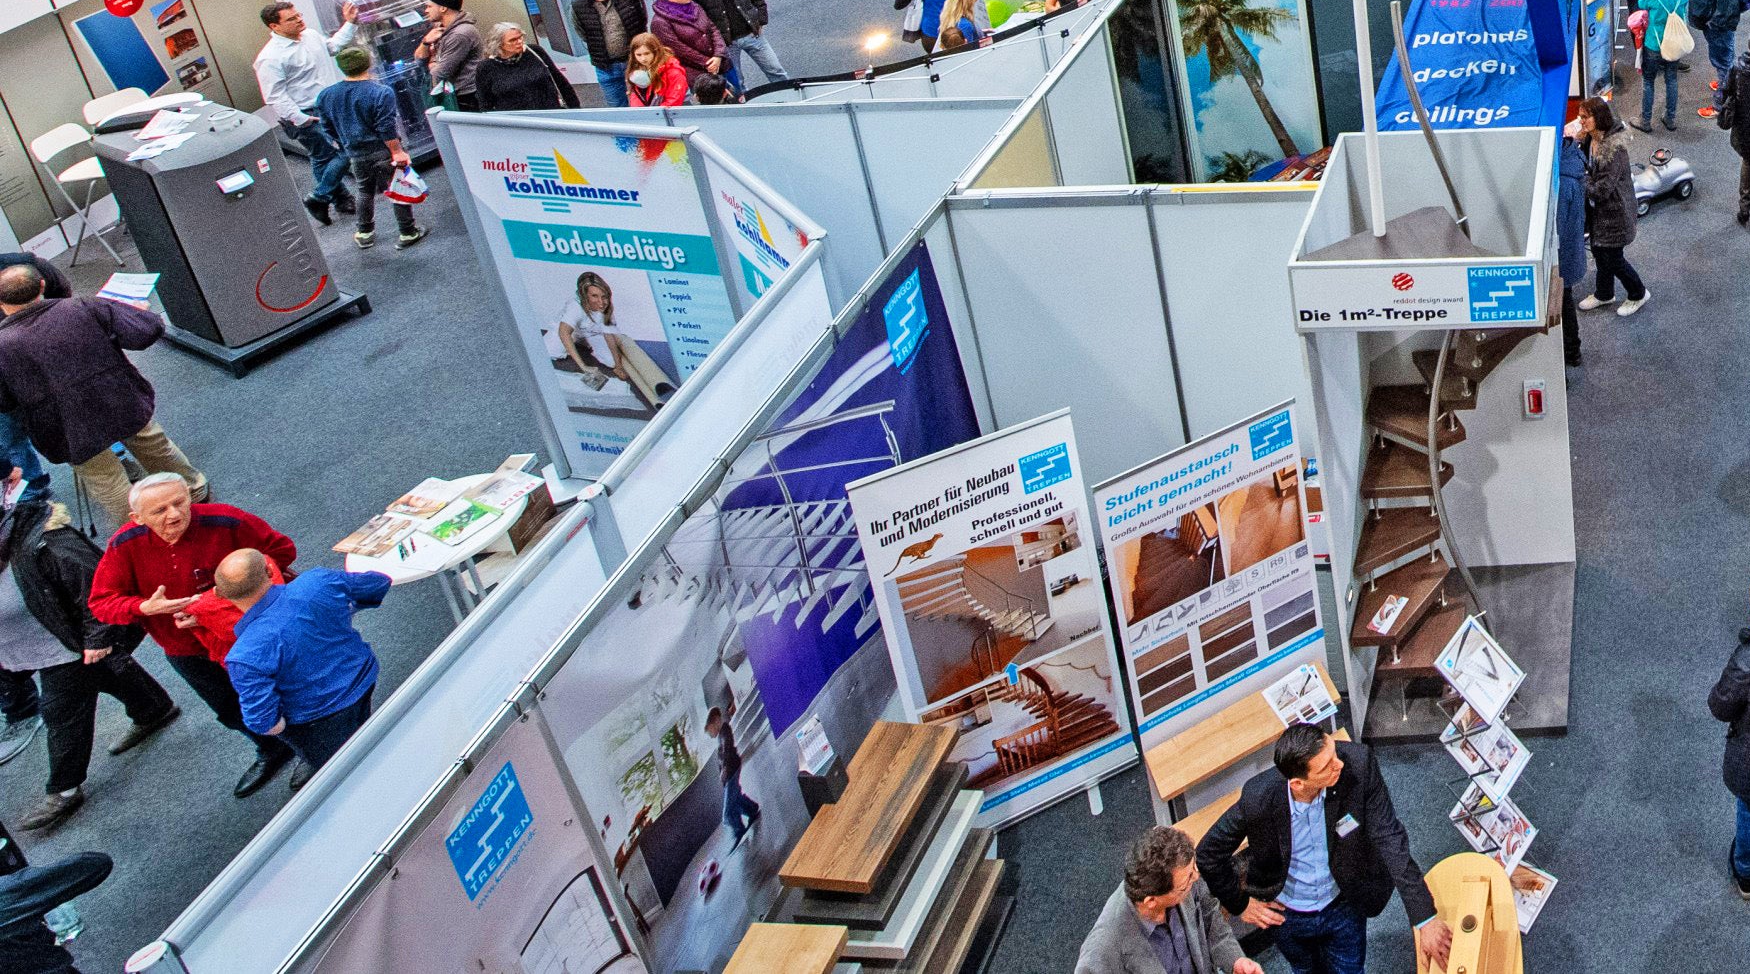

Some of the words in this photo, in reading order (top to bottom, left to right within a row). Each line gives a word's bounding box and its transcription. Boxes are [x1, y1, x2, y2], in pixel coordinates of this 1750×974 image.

[1412, 28, 1529, 49] plafonds
[1414, 58, 1517, 83] decken
[482, 159, 528, 174] maler
[504, 176, 640, 202] kohlhammer
[720, 189, 745, 214] maler
[538, 228, 686, 271] Bodenbeläge
[663, 278, 690, 286] Laminat
[1470, 268, 1531, 277] KENNGOTT
[668, 291, 693, 301] Teppich
[884, 272, 918, 316] KENNGOTT
[672, 306, 688, 315] PVC
[1299, 309, 1331, 322] Die
[1338, 307, 1448, 322] 1m²-Treppe
[1472, 310, 1535, 320] TREPPEN
[677, 321, 702, 330] Parkett
[681, 336, 710, 345] Linoleum
[1250, 412, 1288, 433] KENNGOTT
[1020, 444, 1066, 465] KENNGOTT
[1254, 439, 1292, 459] TREPPEN
[1026, 472, 1072, 493] TREPPEN
[1105, 442, 1240, 511] Stufenaustausch
[870, 519, 889, 535] Ihr
[892, 496, 941, 524] Partner
[944, 485, 962, 502] für
[966, 463, 1015, 492] Neubau
[1108, 500, 1153, 527] leicht
[1158, 461, 1233, 507] gemacht!
[1111, 526, 1138, 542] Große
[1139, 508, 1175, 529] Auswahl
[1175, 503, 1188, 514] für
[1189, 497, 1202, 507] ein
[1203, 482, 1236, 500] schönes
[1236, 453, 1294, 483] Wohnambiente
[880, 528, 905, 548] und
[908, 481, 1010, 536] Modernisierung
[971, 491, 1057, 530] Professionell,
[970, 519, 1016, 544] schnell
[1019, 510, 1042, 526] und
[1045, 502, 1064, 518] gut
[1270, 557, 1284, 568] R9
[1199, 590, 1257, 624] rutschhemmender
[1257, 573, 1290, 593] Oberfläche
[449, 767, 510, 847] KENNGOTT
[470, 813, 531, 892] TREPPEN
